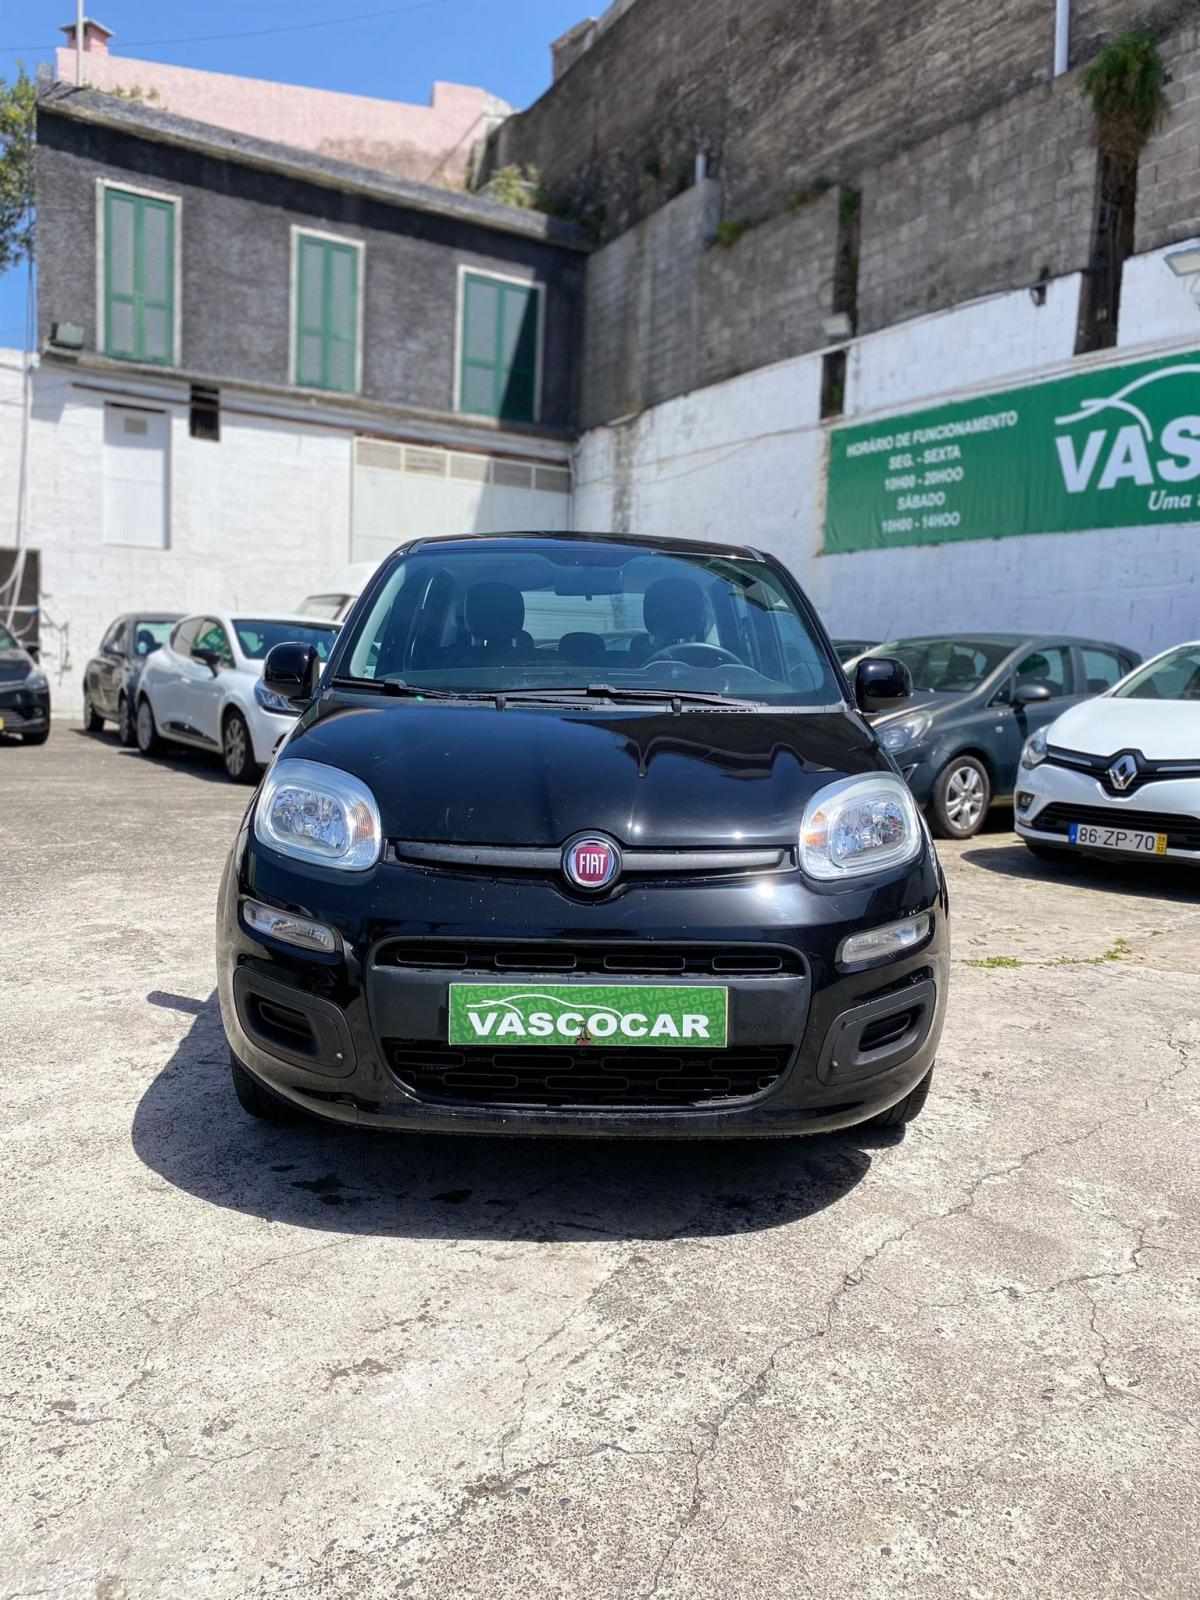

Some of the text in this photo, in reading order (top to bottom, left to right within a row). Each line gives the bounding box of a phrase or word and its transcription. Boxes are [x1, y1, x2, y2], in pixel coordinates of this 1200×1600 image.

[895, 431, 912, 449] DE
[913, 410, 1018, 444] FUNCIONAMENTO
[923, 444, 961, 464] SEXTA
[1055, 415, 1200, 494] VAS
[896, 491, 945, 511] SÁBADO
[1147, 489, 1192, 511] Uma
[579, 853, 605, 874] FIAT
[468, 1012, 710, 1038] VASCOCAR
